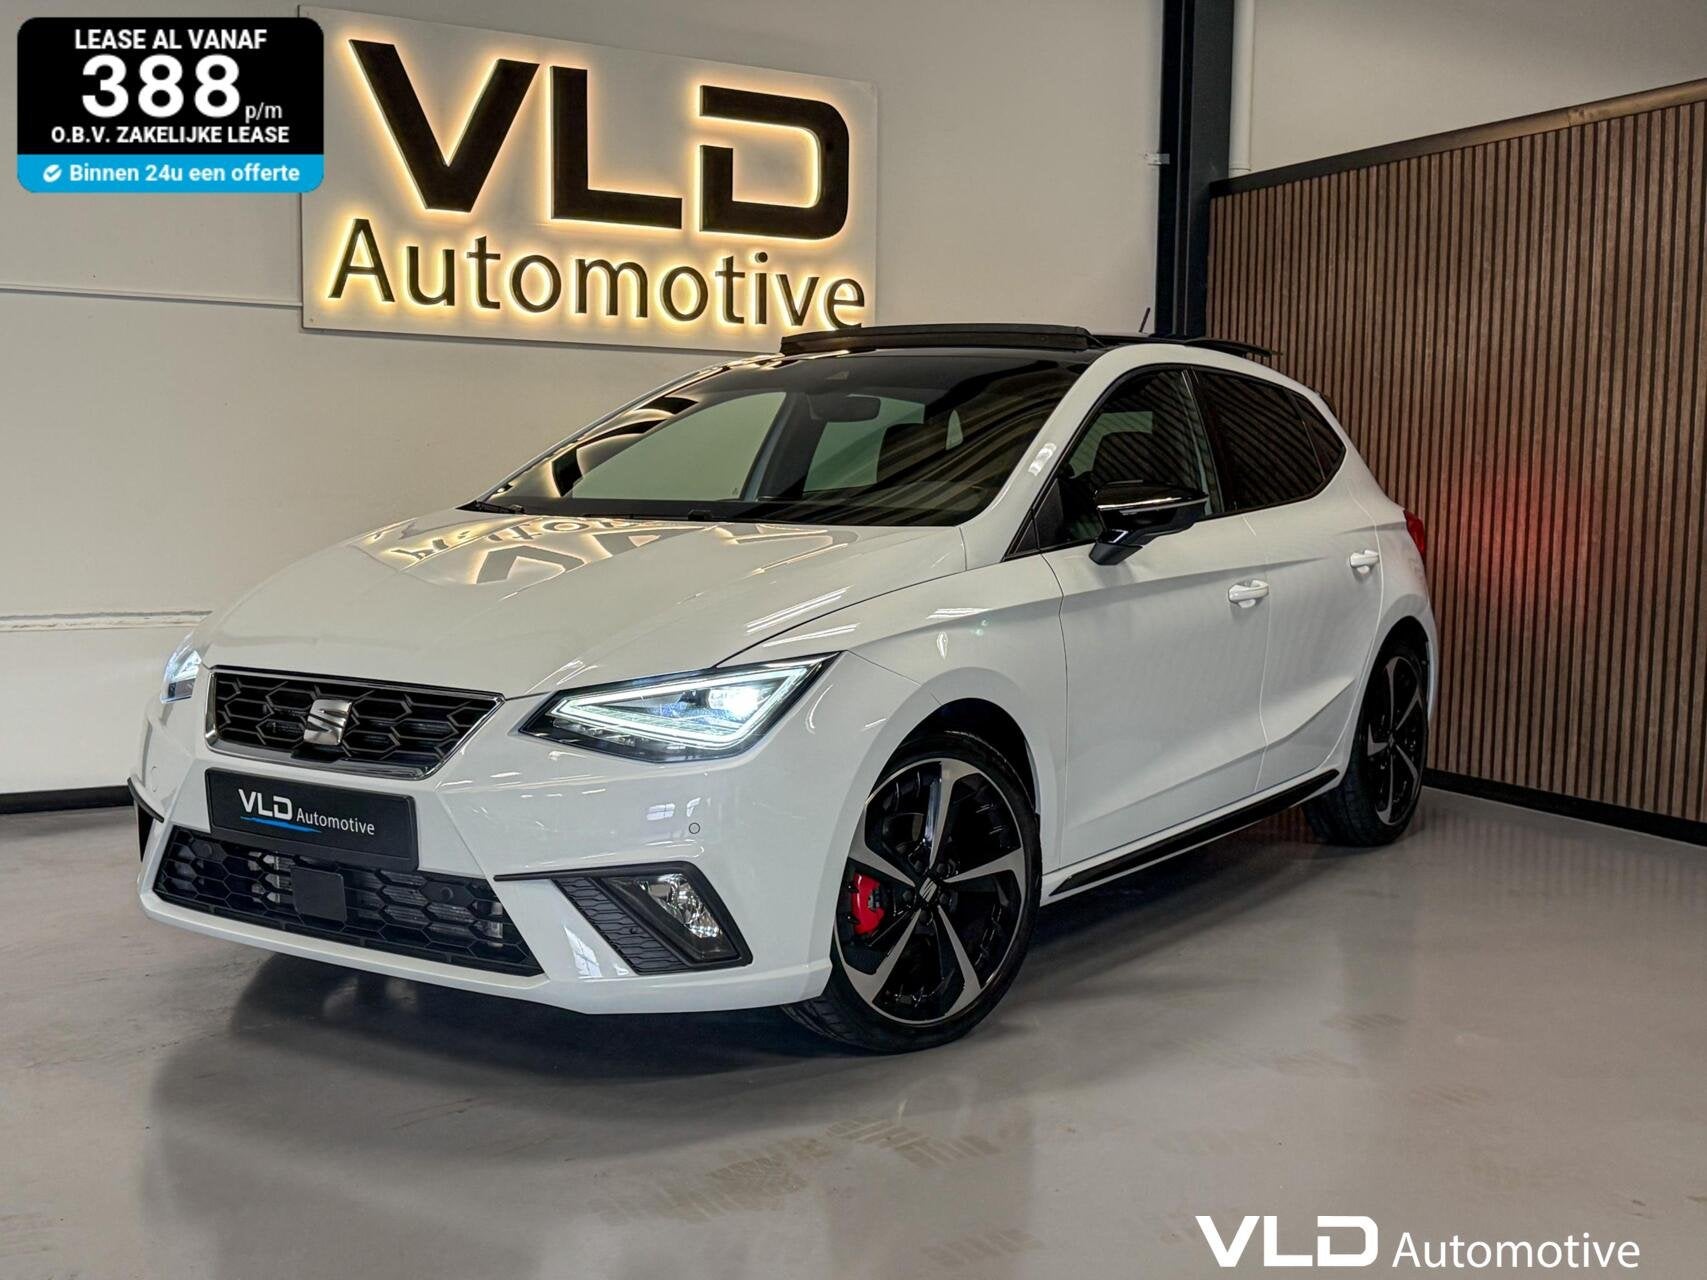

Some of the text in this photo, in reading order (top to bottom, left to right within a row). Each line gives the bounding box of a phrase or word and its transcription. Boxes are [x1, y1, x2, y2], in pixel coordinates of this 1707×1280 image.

[348, 38, 850, 241] VLD
[328, 217, 866, 330] Automotive
[238, 788, 376, 836] VLD Automotive
